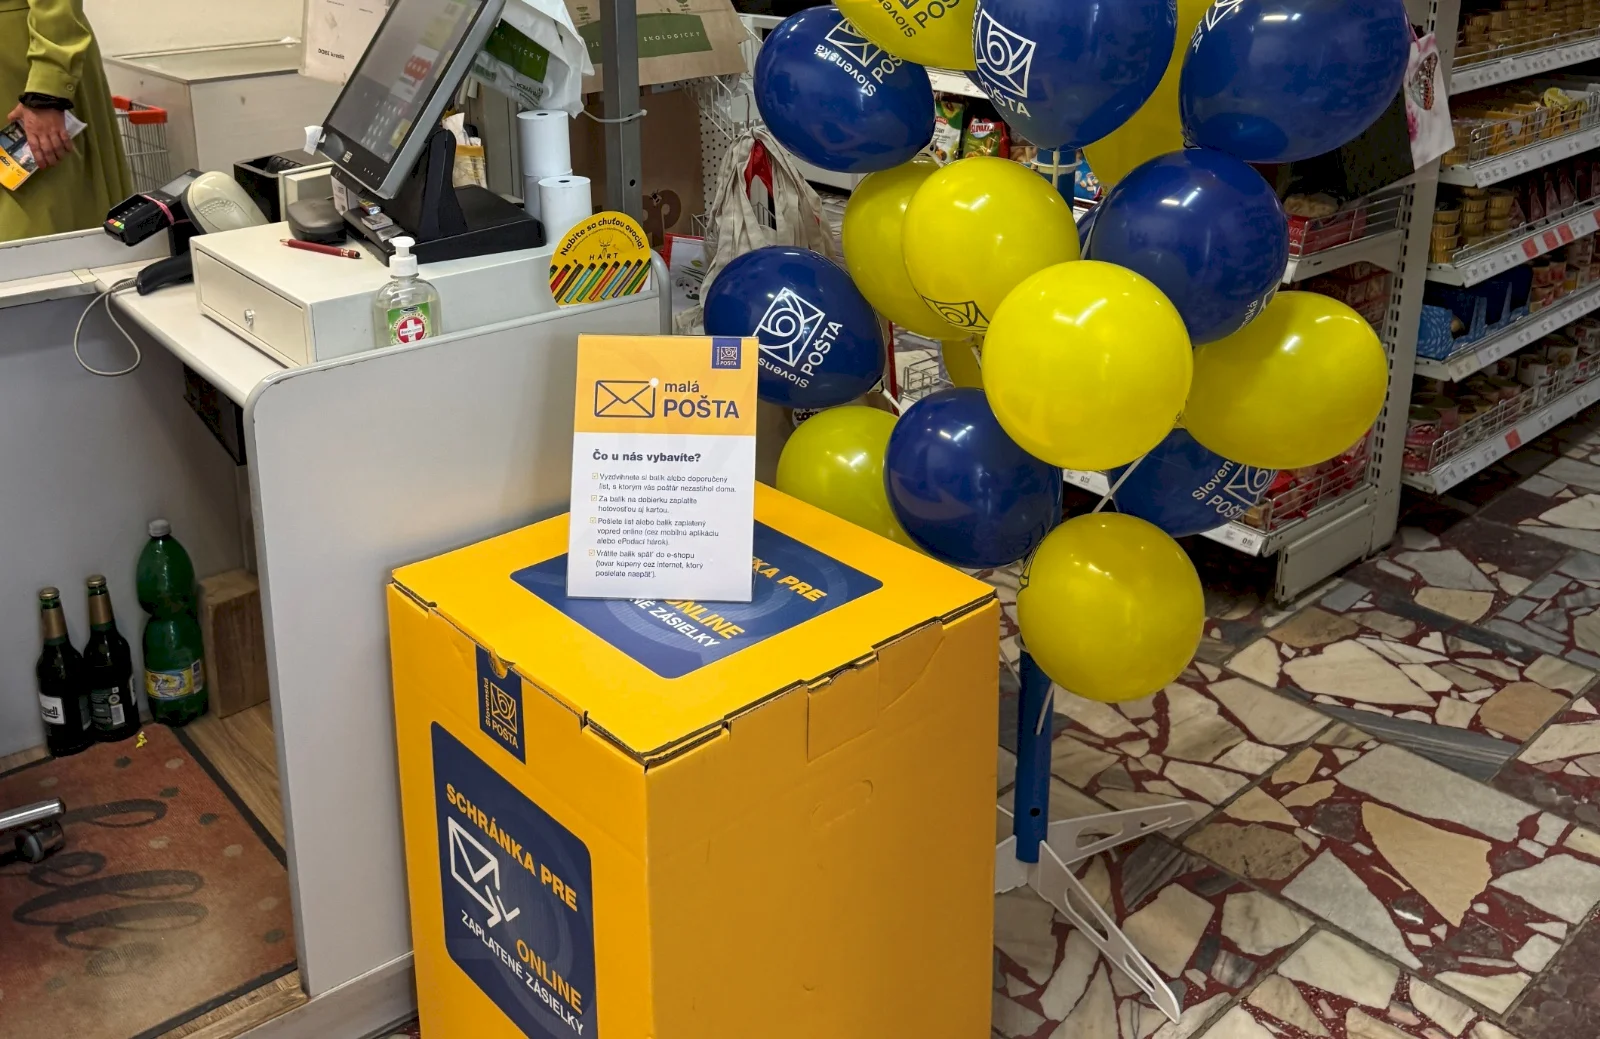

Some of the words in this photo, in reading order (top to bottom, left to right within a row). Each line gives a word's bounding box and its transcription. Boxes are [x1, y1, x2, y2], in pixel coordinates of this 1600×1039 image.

[814, 44, 877, 97] Slovenská
[560, 229, 585, 256] Nabite
[587, 222, 597, 231] sa
[598, 217, 625, 227] chuťou
[625, 224, 645, 250] ovocia!
[589, 252, 618, 260] HART
[801, 322, 843, 376] POŠTA
[664, 380, 700, 392] malá
[664, 395, 740, 418] POŠTA
[592, 449, 608, 461] Čo
[622, 452, 643, 462] nás
[646, 452, 701, 463] vybavíte?
[618, 484, 642, 492] ktorým
[687, 475, 728, 484] doporučený
[638, 496, 668, 504] dobierku
[646, 506, 669, 514] kartou.
[597, 528, 620, 536] vopred
[686, 562, 704, 570] ktorý
[752, 556, 780, 578] KA
[776, 575, 828, 602] PRE
[648, 606, 720, 648] ZÁSIELKY
[492, 720, 518, 749] POŠTA
[446, 783, 536, 876] SCHRÁNKA
[540, 864, 578, 912] PRE
[462, 910, 523, 979] ZAPLATENÉ
[526, 972, 584, 1036] ZÁSIELKY
[516, 939, 582, 1015] ONLINE
